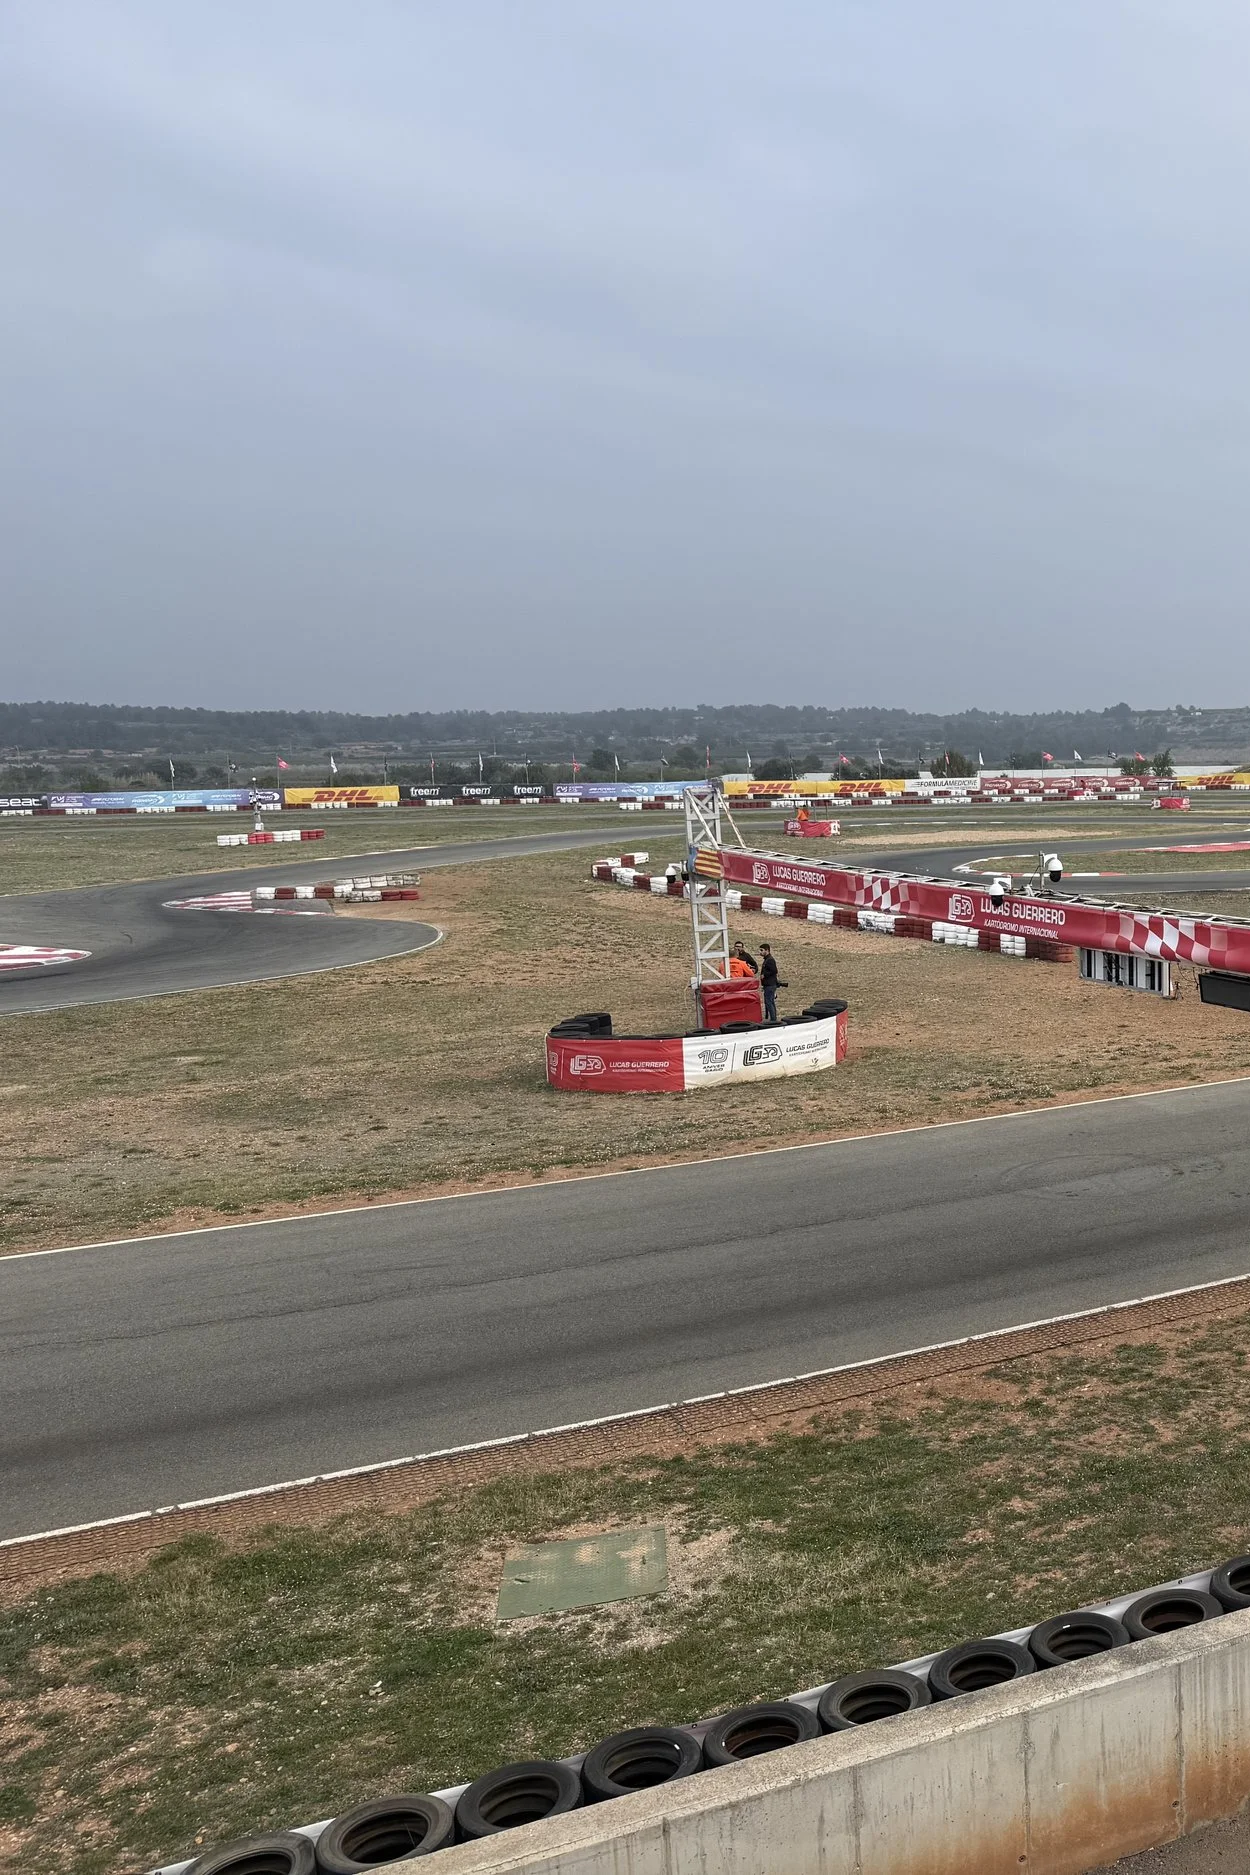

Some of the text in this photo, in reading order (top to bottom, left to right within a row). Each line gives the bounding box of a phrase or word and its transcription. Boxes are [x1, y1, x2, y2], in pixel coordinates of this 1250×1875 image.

[410, 787, 440, 796] freem
[462, 786, 491, 796] freem
[513, 785, 542, 795] freem
[747, 783, 796, 794] DHL
[839, 782, 885, 792] DHL
[313, 790, 373, 802] DHL
[772, 865, 792, 880] LUCAS
[792, 869, 826, 886] GUERRERO
[1012, 902, 1066, 926] GUERRERO
